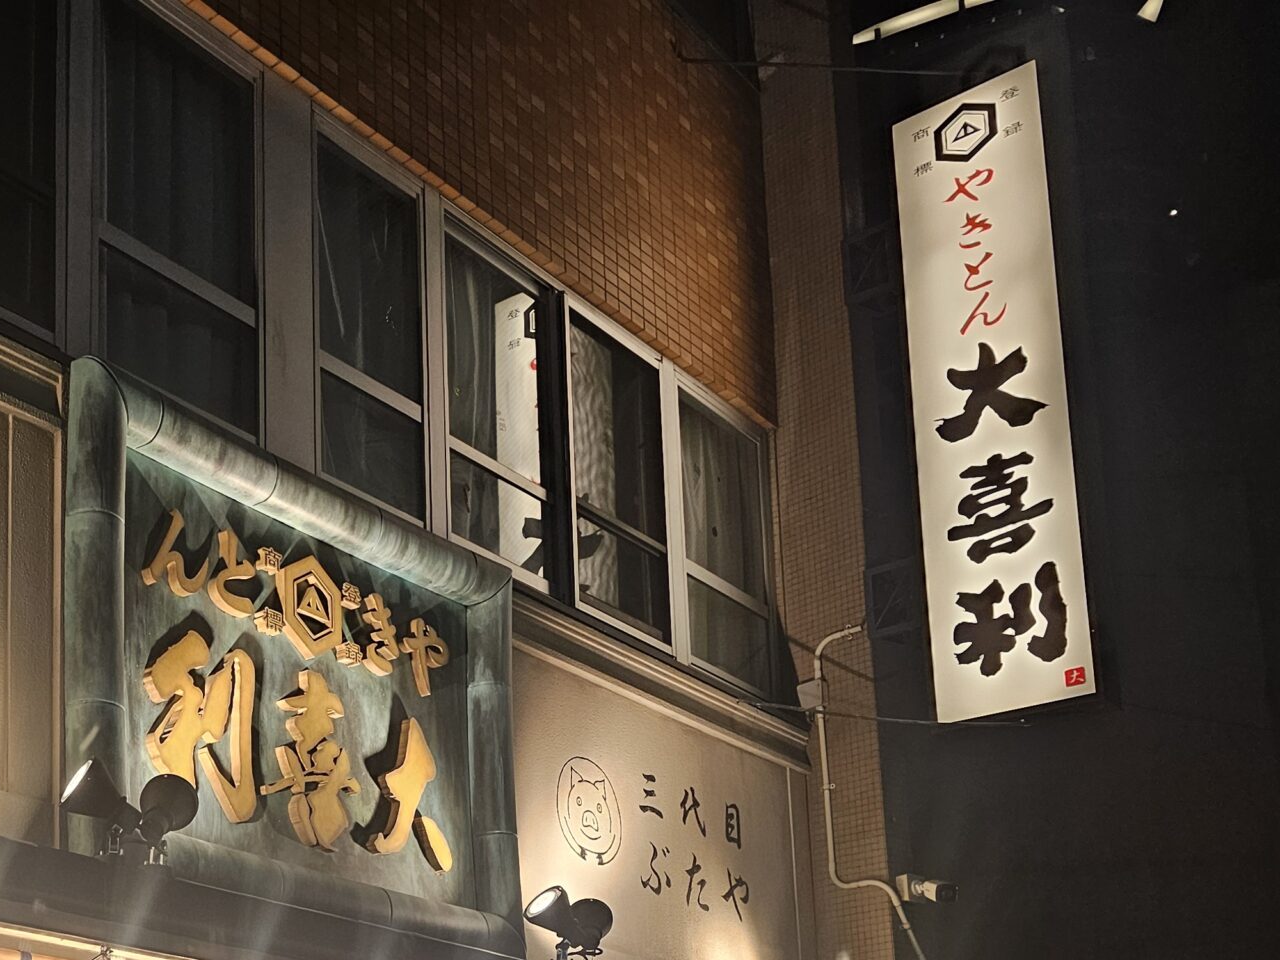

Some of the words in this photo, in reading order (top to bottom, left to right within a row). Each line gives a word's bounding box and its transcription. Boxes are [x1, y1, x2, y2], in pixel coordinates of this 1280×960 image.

[942, 167, 1008, 337] やきとん
[934, 341, 1070, 677] 大喜利
[638, 772, 743, 851] 三代目
[640, 841, 751, 923] ぶたや
